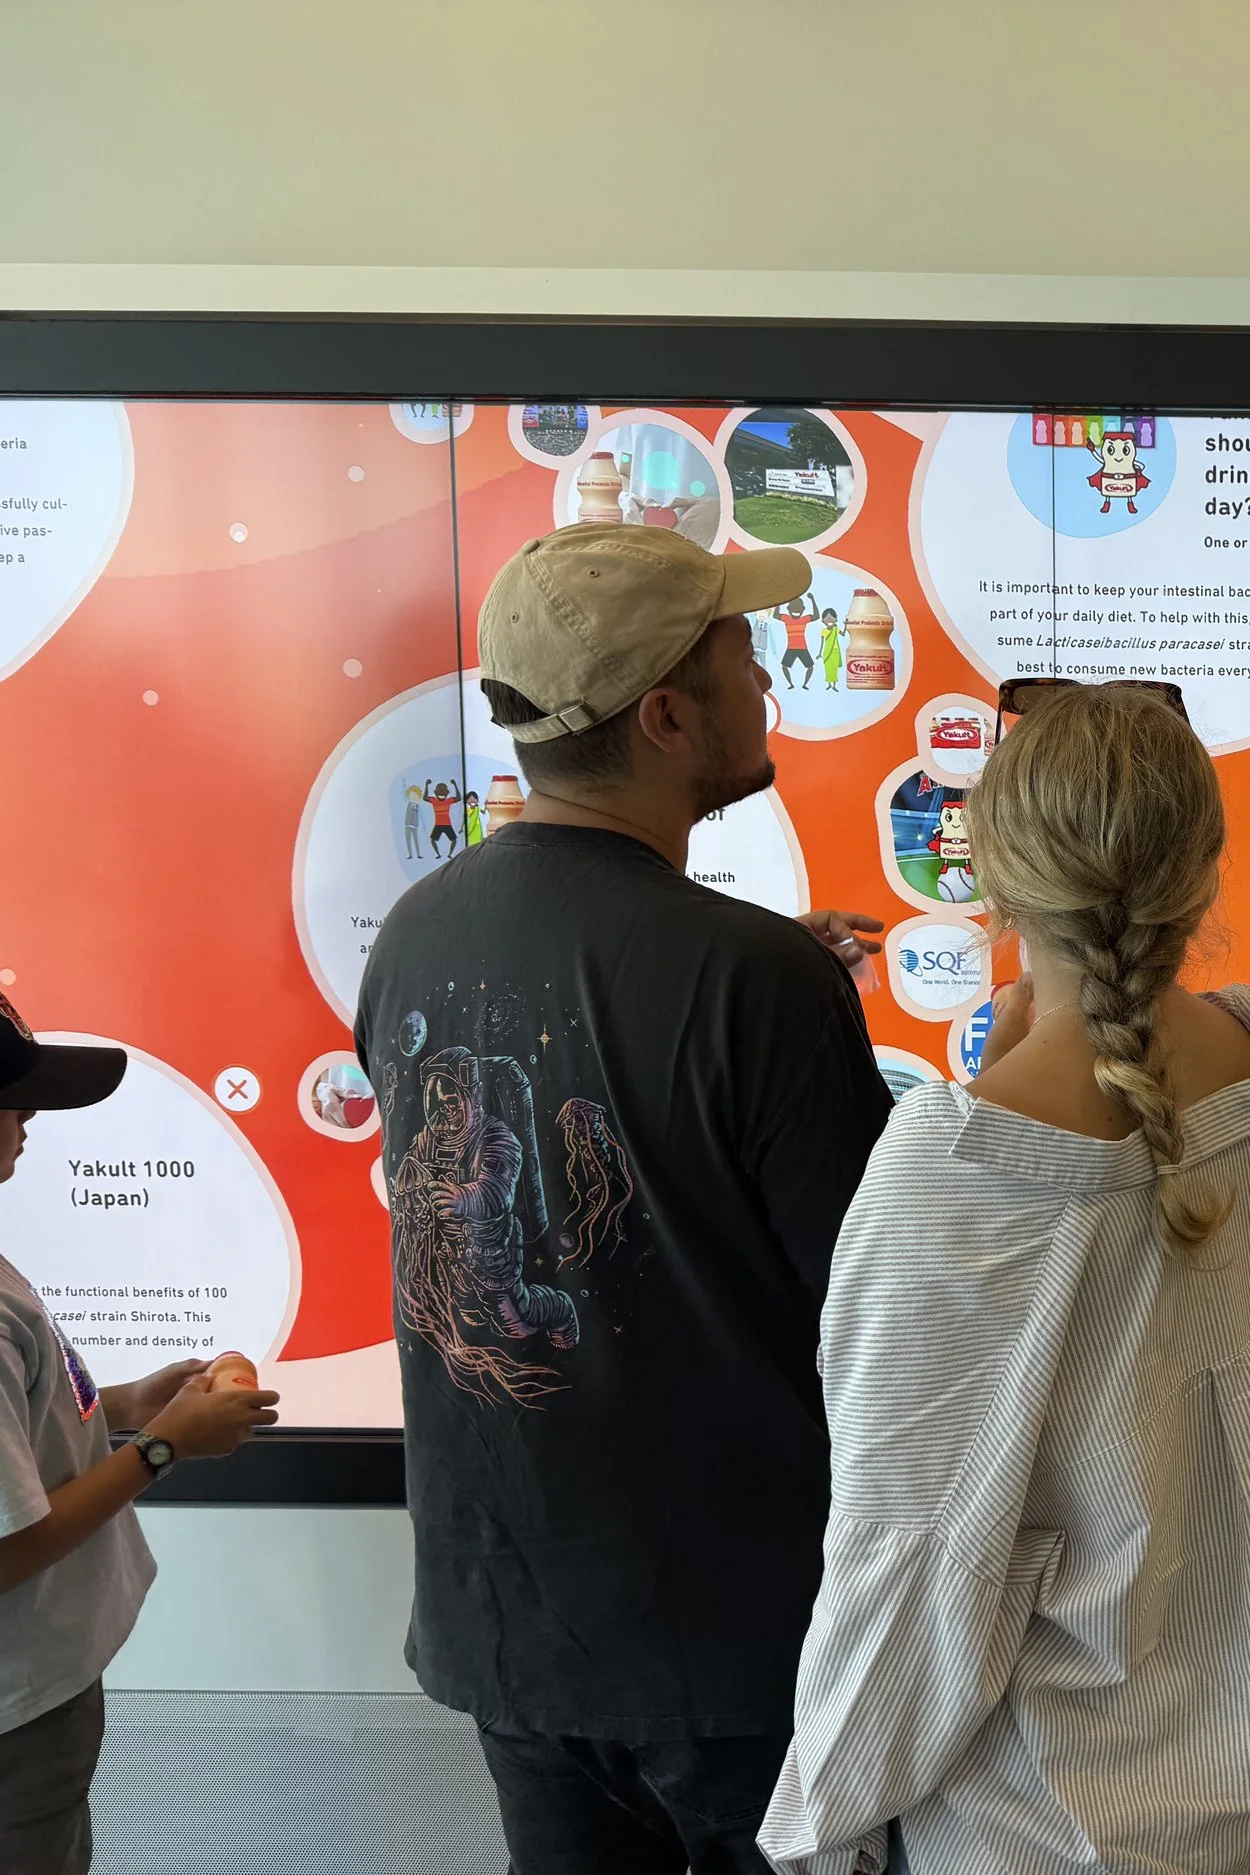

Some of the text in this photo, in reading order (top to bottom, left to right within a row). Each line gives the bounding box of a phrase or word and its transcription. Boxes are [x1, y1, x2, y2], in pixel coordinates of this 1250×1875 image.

[0, 436, 28, 449] eria
[0, 497, 68, 512] sfully cul-
[1203, 535, 1230, 548] One
[1233, 539, 1249, 548] or
[17, 553, 25, 562] a
[979, 579, 988, 592] It
[991, 580, 1003, 592] is
[1006, 580, 1074, 596] important
[1076, 583, 1090, 595] to
[1093, 583, 1126, 598] keep
[1128, 586, 1160, 598] your
[1162, 584, 1225, 597] intestinal
[989, 607, 1018, 622] part
[1020, 607, 1034, 620] of
[1036, 610, 1069, 622] your
[1072, 609, 1105, 624] daily
[1107, 609, 1136, 622] diet.
[1139, 610, 1157, 623] To
[1160, 610, 1189, 625] help
[1191, 611, 1221, 623] with
[996, 636, 1034, 646] sume
[1035, 634, 1157, 649] Lacticaseibacillus
[1158, 637, 1226, 652] paracasei
[853, 663, 888, 672] Yakult
[1016, 660, 1044, 675] best
[1047, 661, 1062, 675] to
[1065, 665, 1126, 677] consume
[1129, 666, 1157, 677] new
[1159, 663, 1215, 678] bacteria
[942, 731, 972, 739] Yakult
[693, 871, 735, 883] health
[922, 951, 966, 975] SQF
[67, 1159, 195, 1178] Yakult 1000
[70, 1186, 150, 1210] (Japan)
[41, 1285, 62, 1298] the
[64, 1285, 130, 1297] functional
[132, 1286, 185, 1297] benefits
[187, 1286, 201, 1298] of
[203, 1286, 228, 1298] 100
[89, 1310, 127, 1321] strain
[130, 1310, 181, 1322] Shirota.
[183, 1310, 212, 1322] This
[71, 1334, 214, 1349] number and density of
